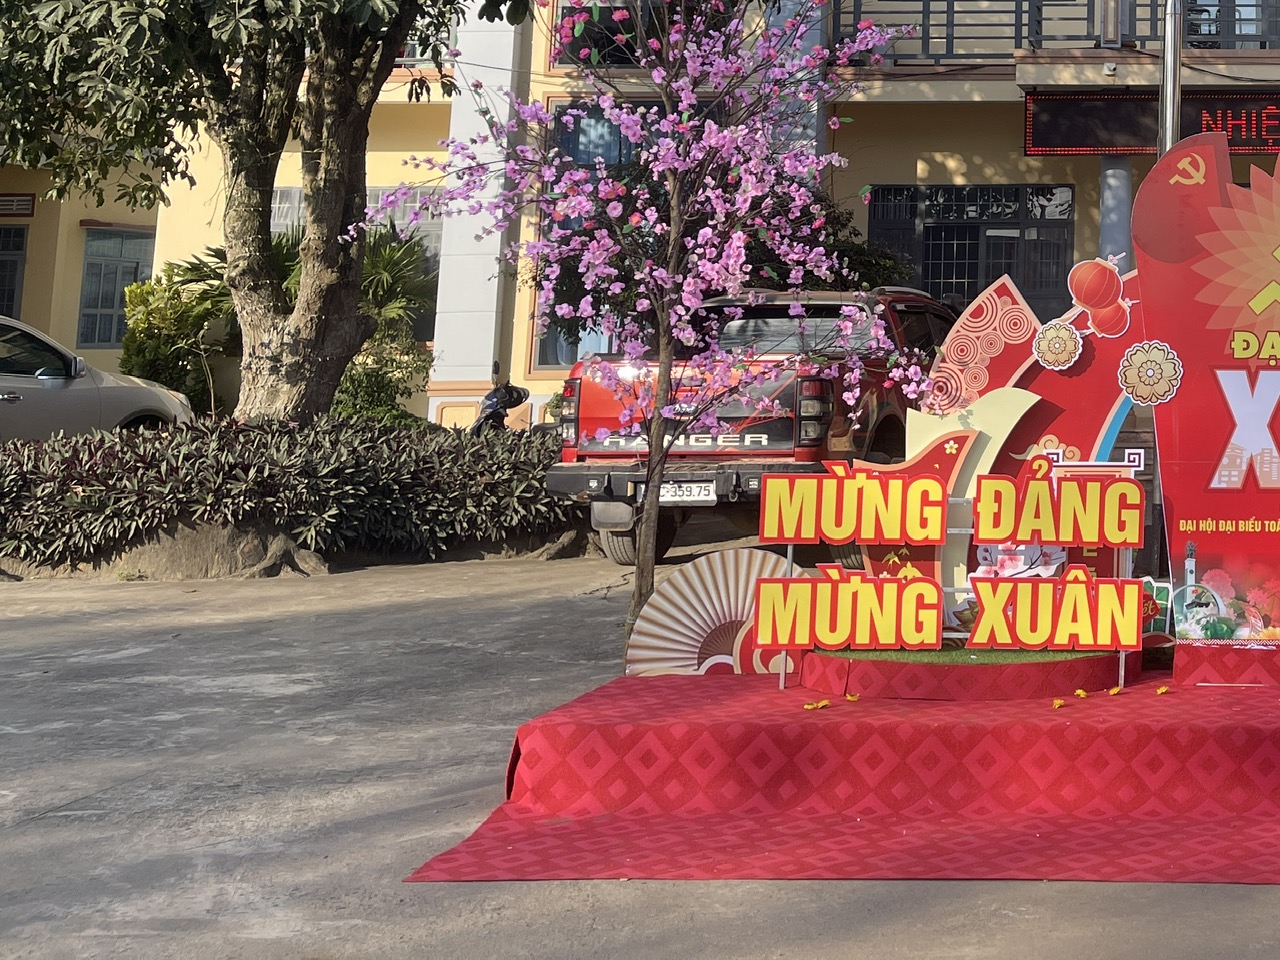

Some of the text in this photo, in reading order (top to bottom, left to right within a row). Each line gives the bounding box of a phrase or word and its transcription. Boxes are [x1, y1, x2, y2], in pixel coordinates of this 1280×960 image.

[763, 458, 1140, 544] MỪNG ĐẢNG
[1180, 519, 1196, 534] ĐẠI
[1199, 518, 1216, 534] HỘI
[1219, 520, 1236, 534] ĐẠI
[1238, 516, 1261, 532] BIỂU
[756, 568, 1139, 646] MỪNG XUÂN
